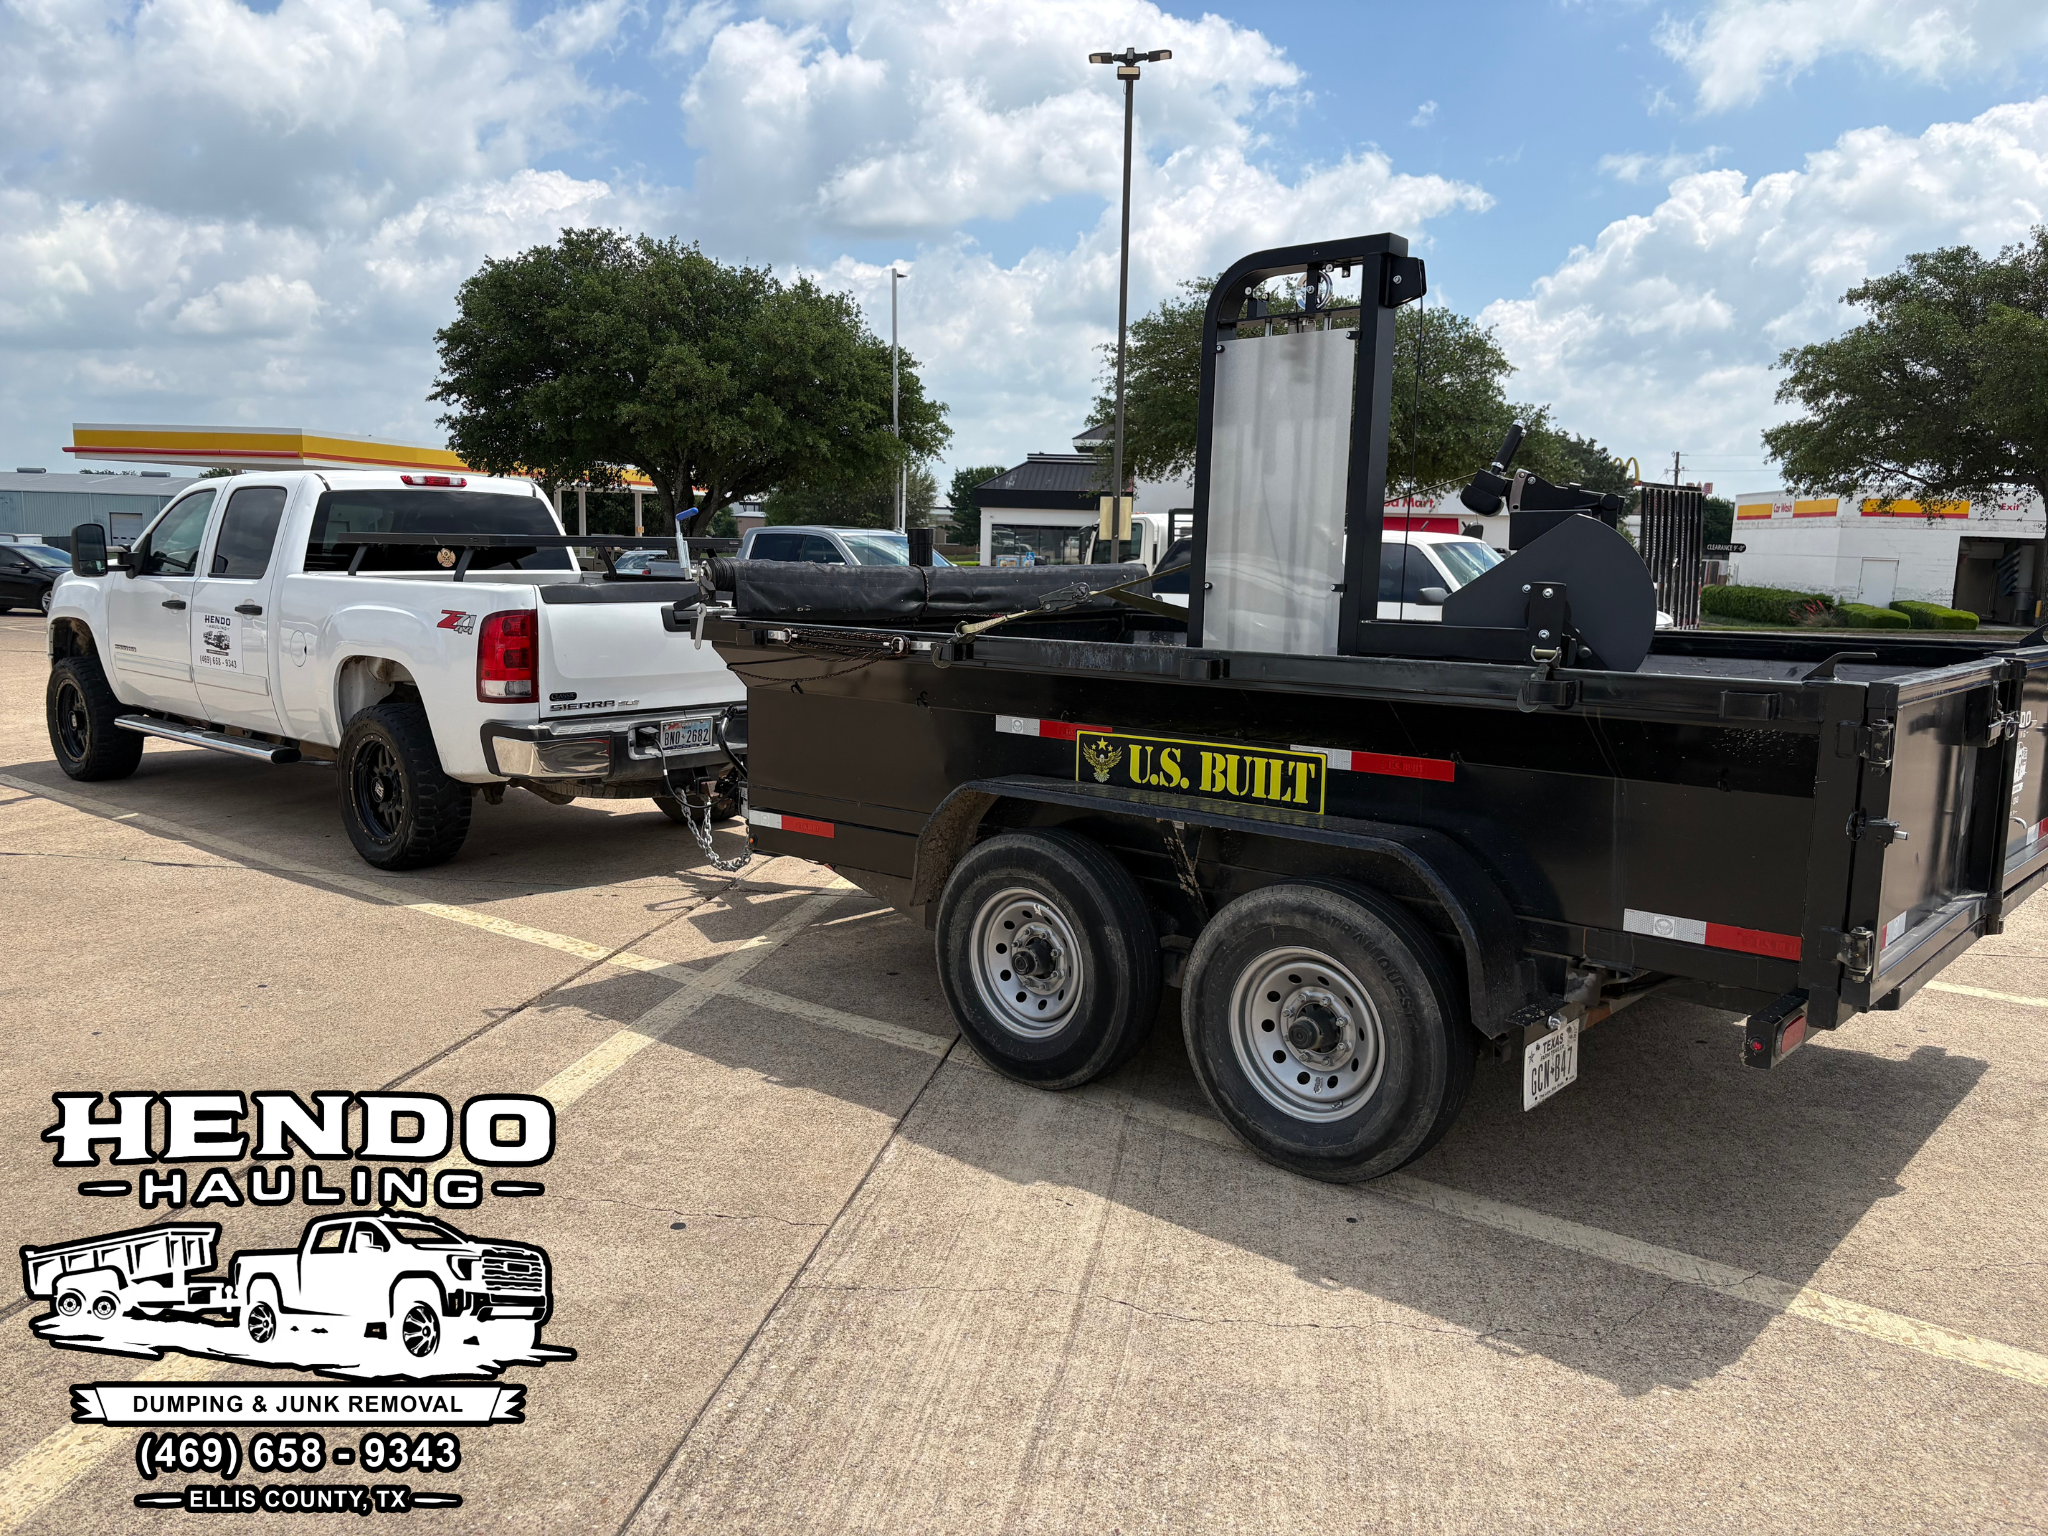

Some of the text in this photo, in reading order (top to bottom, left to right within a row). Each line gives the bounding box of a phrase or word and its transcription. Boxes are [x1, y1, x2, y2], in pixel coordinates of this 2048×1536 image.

[1402, 496, 1434, 508] Mart
[1773, 502, 1793, 514] Car Wash
[2001, 502, 2020, 511] Exit
[1706, 543, 1733, 551] CLEARANCE
[204, 614, 231, 626] HENDO
[549, 699, 616, 712] SIERRA
[1128, 743, 1316, 805] U.S. BUILT
[1543, 1032, 1564, 1054] TEXAS
